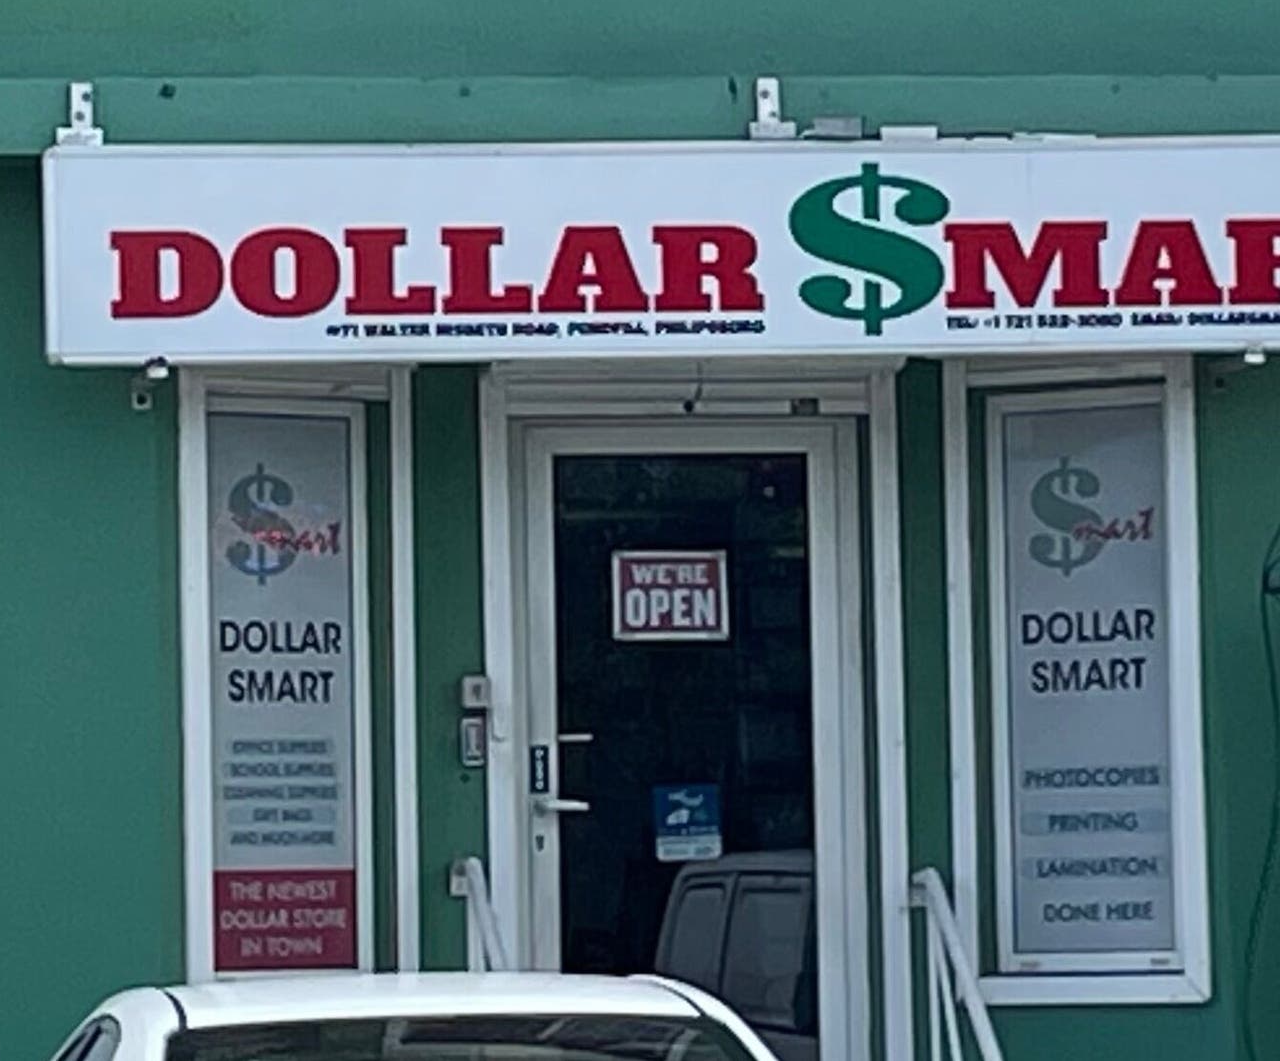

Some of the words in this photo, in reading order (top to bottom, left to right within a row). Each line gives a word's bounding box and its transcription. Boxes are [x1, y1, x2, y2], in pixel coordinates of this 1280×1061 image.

[110, 226, 765, 319] DOLLAR
[631, 564, 709, 584] WE'RE
[624, 588, 717, 627] OPEN
[220, 620, 342, 654] DOLLAR
[1022, 609, 1155, 646] DOLLAR
[228, 669, 334, 703] SMART
[1031, 657, 1146, 693] SMART
[1024, 765, 1160, 788] PHOTOCOPIES
[1047, 812, 1139, 833] PRINTING
[1036, 856, 1157, 878] LAMINATION
[229, 881, 262, 901] THE
[268, 880, 337, 900] NEWEST
[220, 909, 289, 930] DOLLAR
[292, 908, 347, 929] STORE
[1042, 903, 1102, 923] DONE
[1106, 901, 1154, 921] HERE
[241, 937, 259, 958] IN
[268, 936, 323, 957] TOWN
